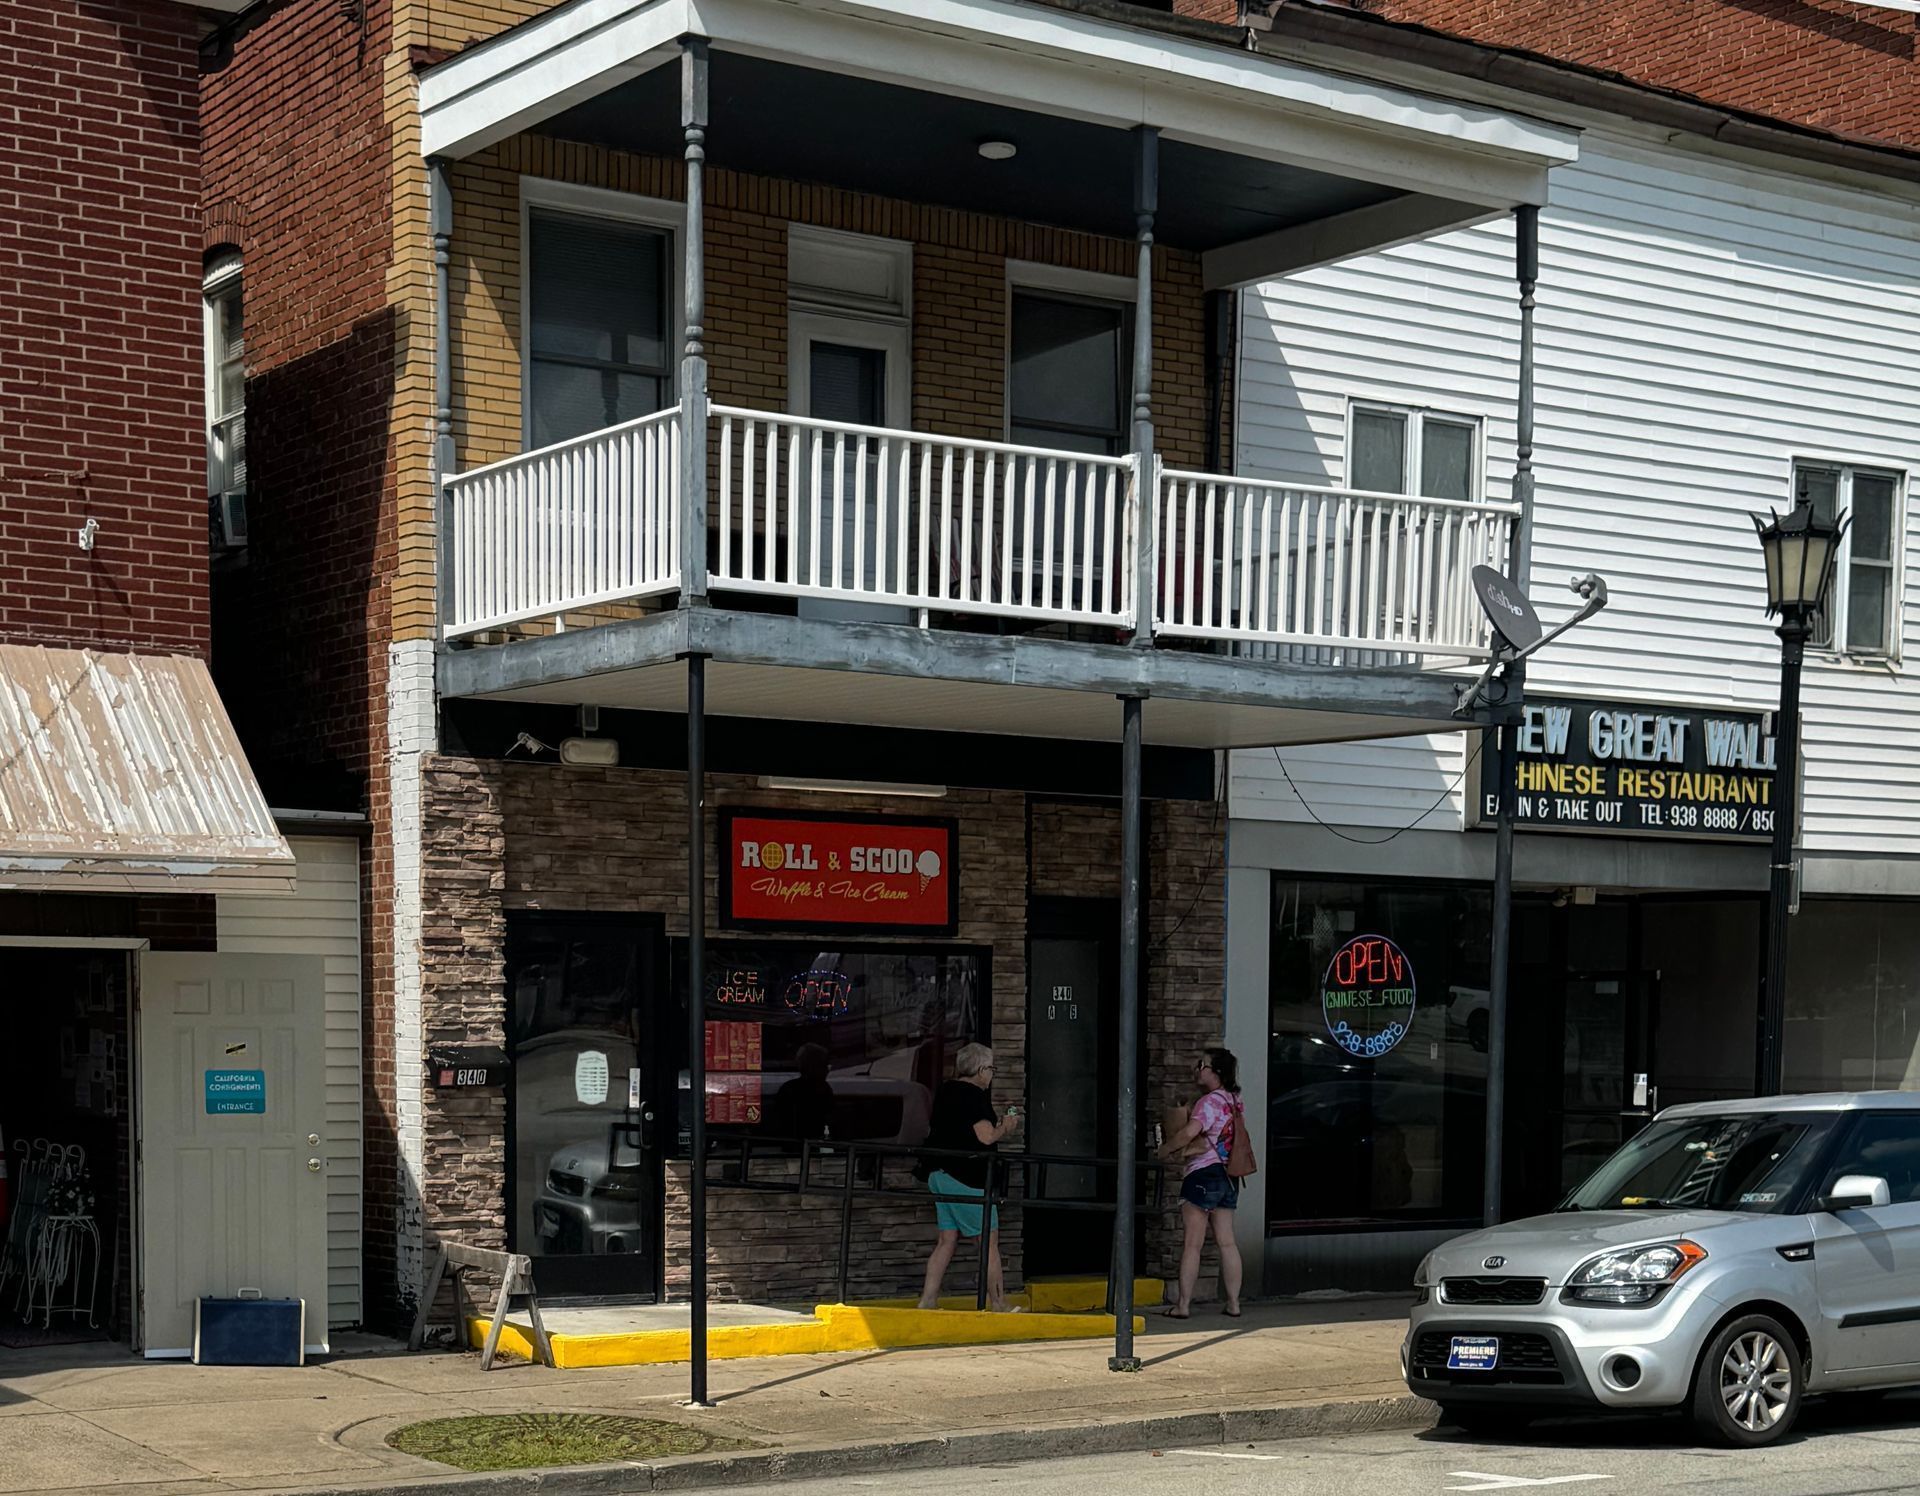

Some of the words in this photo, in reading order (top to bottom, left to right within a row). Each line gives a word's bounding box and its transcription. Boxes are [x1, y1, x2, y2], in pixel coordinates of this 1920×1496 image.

[1589, 709, 1690, 764] GREAT
[1703, 719, 1778, 771] WALL
[1515, 761, 1606, 796] HINESE
[1617, 767, 1774, 805] RESTAURANT
[1518, 796, 1532, 818] IN
[1538, 797, 1549, 819] &
[1555, 799, 1589, 821] TAKE
[1595, 801, 1623, 823] OUT
[828, 852, 841, 870] &
[751, 877, 813, 904] Waffle
[813, 881, 825, 899] &
[829, 880, 862, 899] Ice
[862, 881, 910, 902] Cream
[1337, 941, 1402, 984] OPEN
[725, 971, 758, 986] ICE
[716, 986, 765, 1004] CREAM
[784, 980, 851, 1009] OPEN
[1326, 990, 1373, 1009] CHINESE
[1381, 988, 1413, 1006] FOOD
[457, 1069, 487, 1085] 340
[217, 1103, 254, 1111] ENTRANCE
[1485, 1257, 1503, 1267] KIA
[1453, 1346, 1496, 1356] PREMIERE
